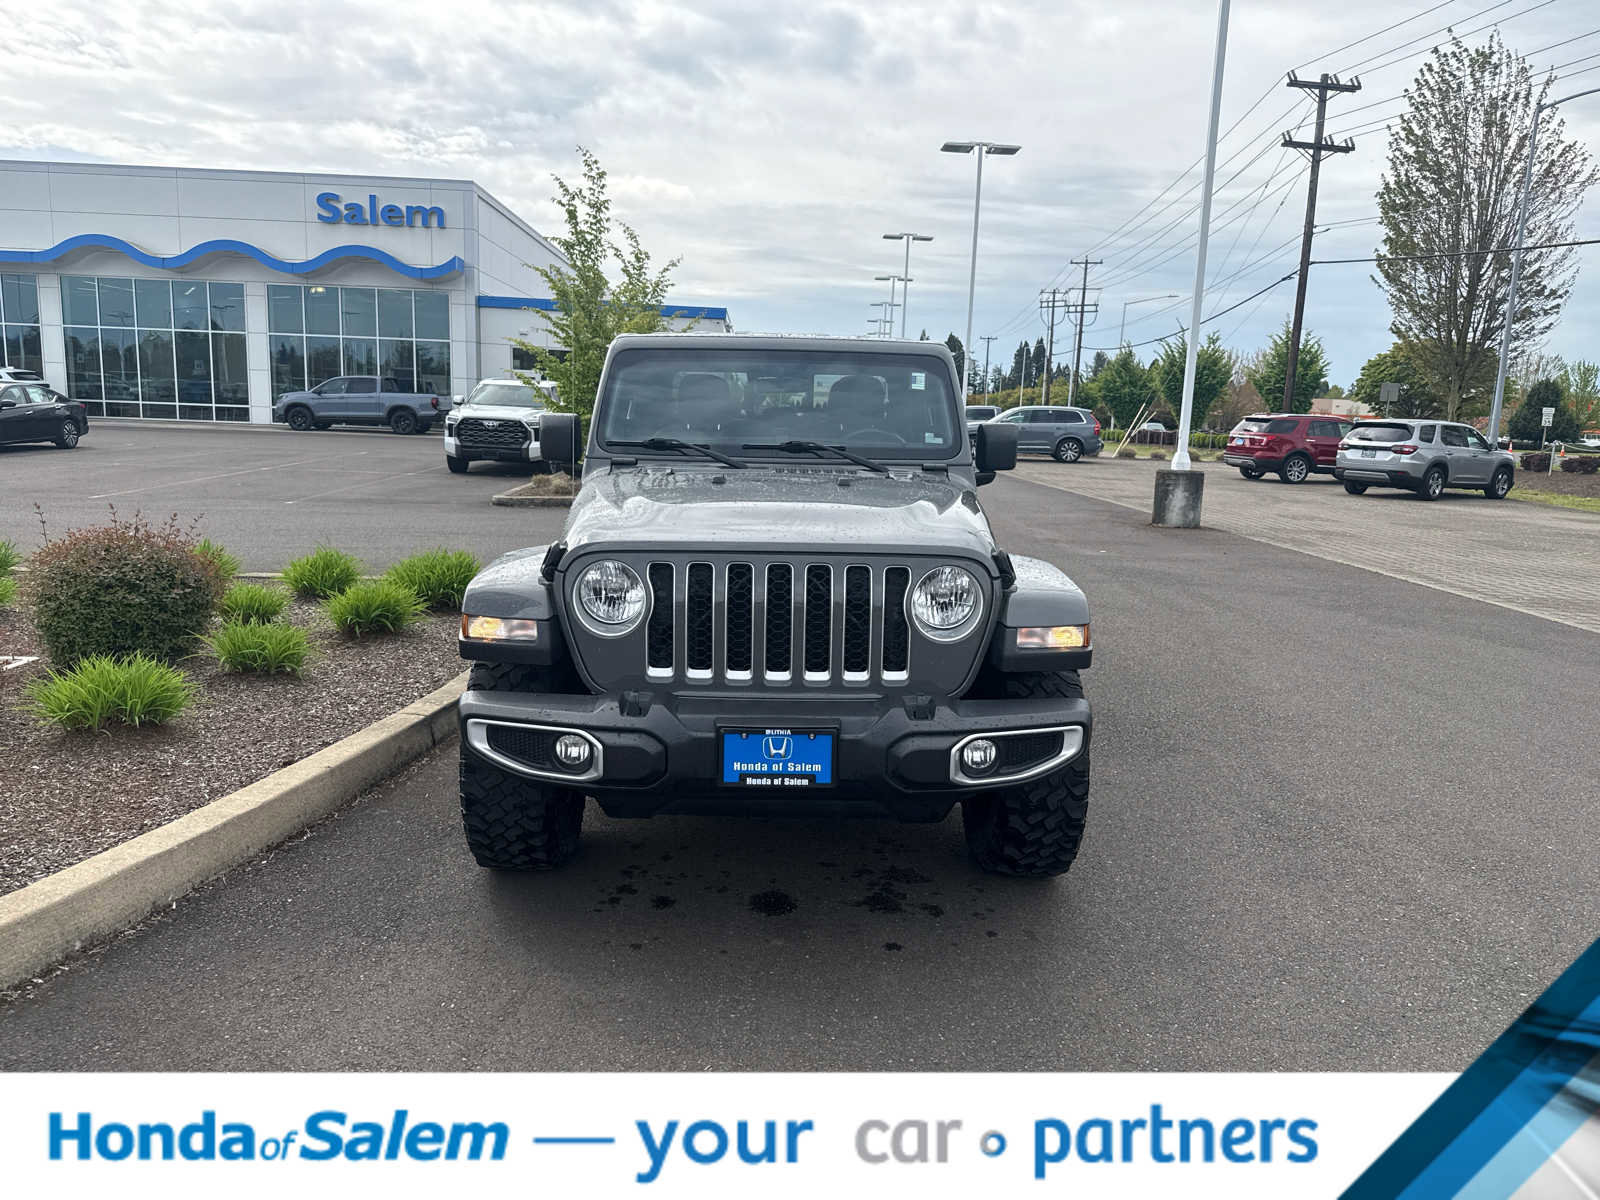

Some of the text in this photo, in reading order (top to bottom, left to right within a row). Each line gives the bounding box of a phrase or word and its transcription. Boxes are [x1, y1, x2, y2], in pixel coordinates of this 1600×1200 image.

[316, 192, 446, 229] Salem
[733, 761, 822, 772] Honda of Salem
[746, 777, 809, 786] Honda of Salem
